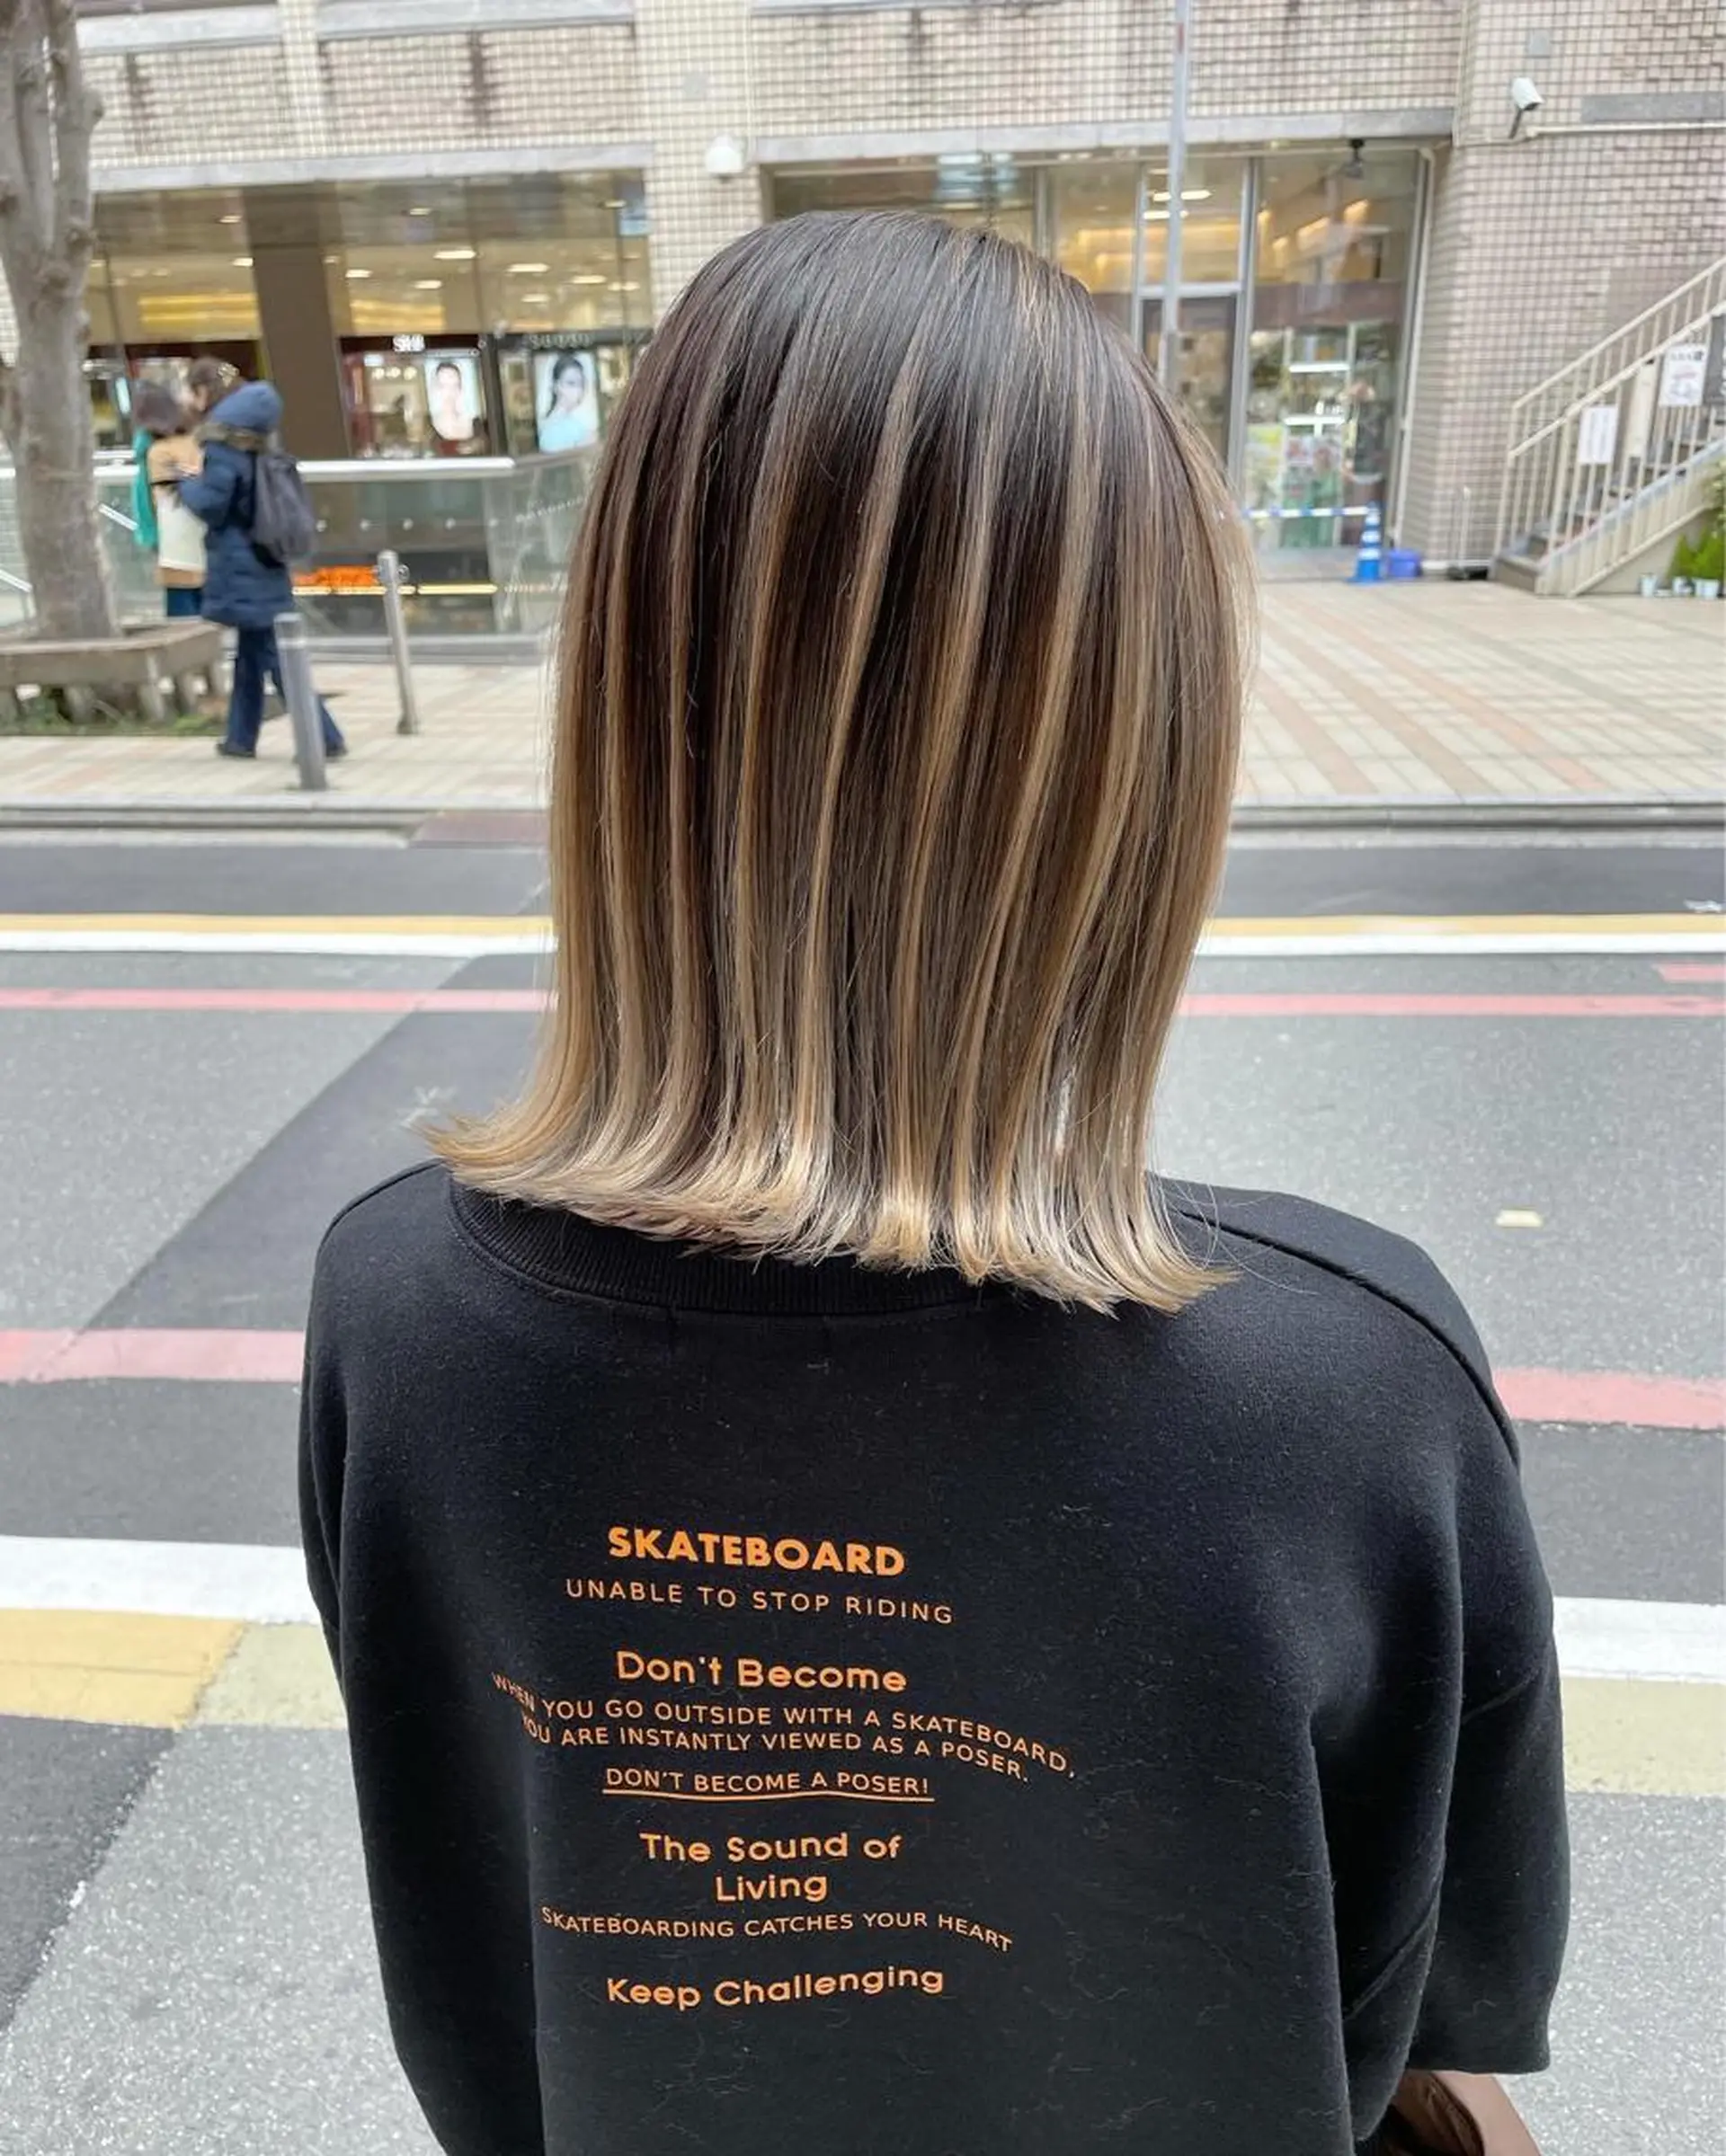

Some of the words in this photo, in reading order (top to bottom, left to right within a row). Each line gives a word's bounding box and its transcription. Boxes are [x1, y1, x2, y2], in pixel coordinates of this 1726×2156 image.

[608, 1526, 905, 1576] SKATEBOARD
[565, 1579, 683, 1604] UNABLE
[698, 1586, 736, 1607] TO
[752, 1591, 829, 1612] STOP
[845, 1596, 954, 1624] RIDING
[616, 1650, 723, 1684] Don't
[737, 1657, 907, 1693] Become
[492, 1673, 535, 1712] WHEN
[542, 1699, 593, 1720] YOU
[605, 1699, 644, 1718] GO
[654, 1702, 772, 1726] OUTSIDE
[784, 1707, 853, 1725] WITH
[863, 1711, 881, 1727] A
[892, 1712, 1076, 1778] SKATEBOARD,
[521, 1710, 551, 1744] YOU
[561, 1727, 609, 1746] ARE
[620, 1727, 750, 1752] INSTANTLY
[762, 1733, 861, 1751] VIEWED
[872, 1736, 903, 1753] AS
[913, 1740, 931, 1756] A
[941, 1741, 1028, 1782] POSER.
[606, 1768, 684, 1789] DON'T
[694, 1772, 800, 1792] BECOME
[809, 1772, 828, 1787] A
[837, 1771, 928, 1795] POSER!
[639, 1832, 712, 1864] The
[727, 1832, 849, 1862] Sound
[862, 1834, 903, 1860] of
[715, 1875, 828, 1903] Living
[541, 1905, 735, 1938] SKATEBOARDING
[744, 1914, 854, 1936] CATCHES
[862, 1912, 929, 1929] YOUR
[939, 1914, 1012, 1953] HEART
[606, 1977, 702, 2011] Keep
[714, 1966, 944, 2007] Challenging
